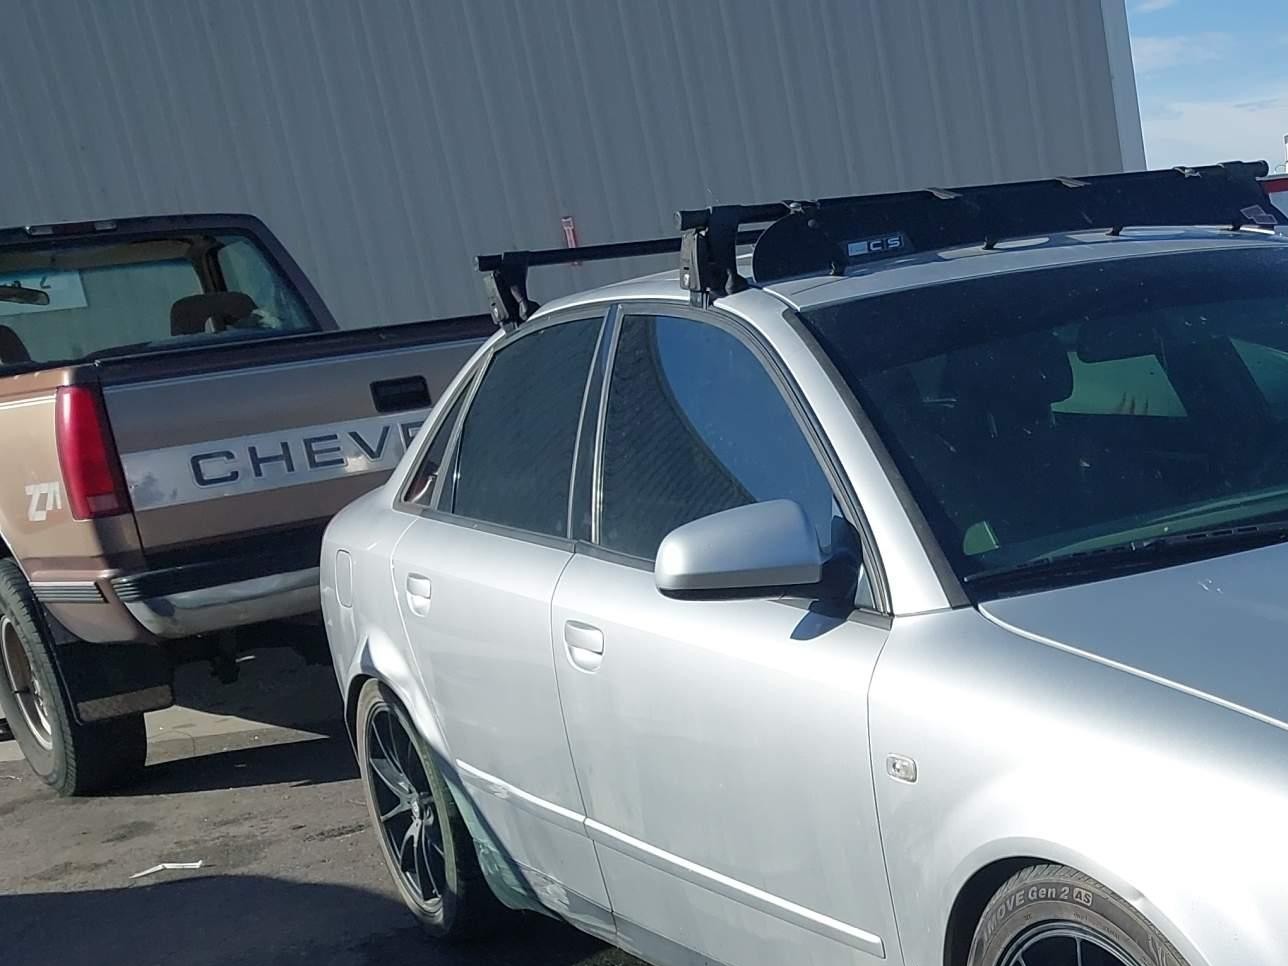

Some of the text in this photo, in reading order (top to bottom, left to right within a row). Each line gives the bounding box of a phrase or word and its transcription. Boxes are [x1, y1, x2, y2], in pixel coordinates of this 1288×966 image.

[1028, 886, 1056, 900] Gen
[1060, 886, 1069, 900] 2
[1074, 888, 1092, 907] AS
